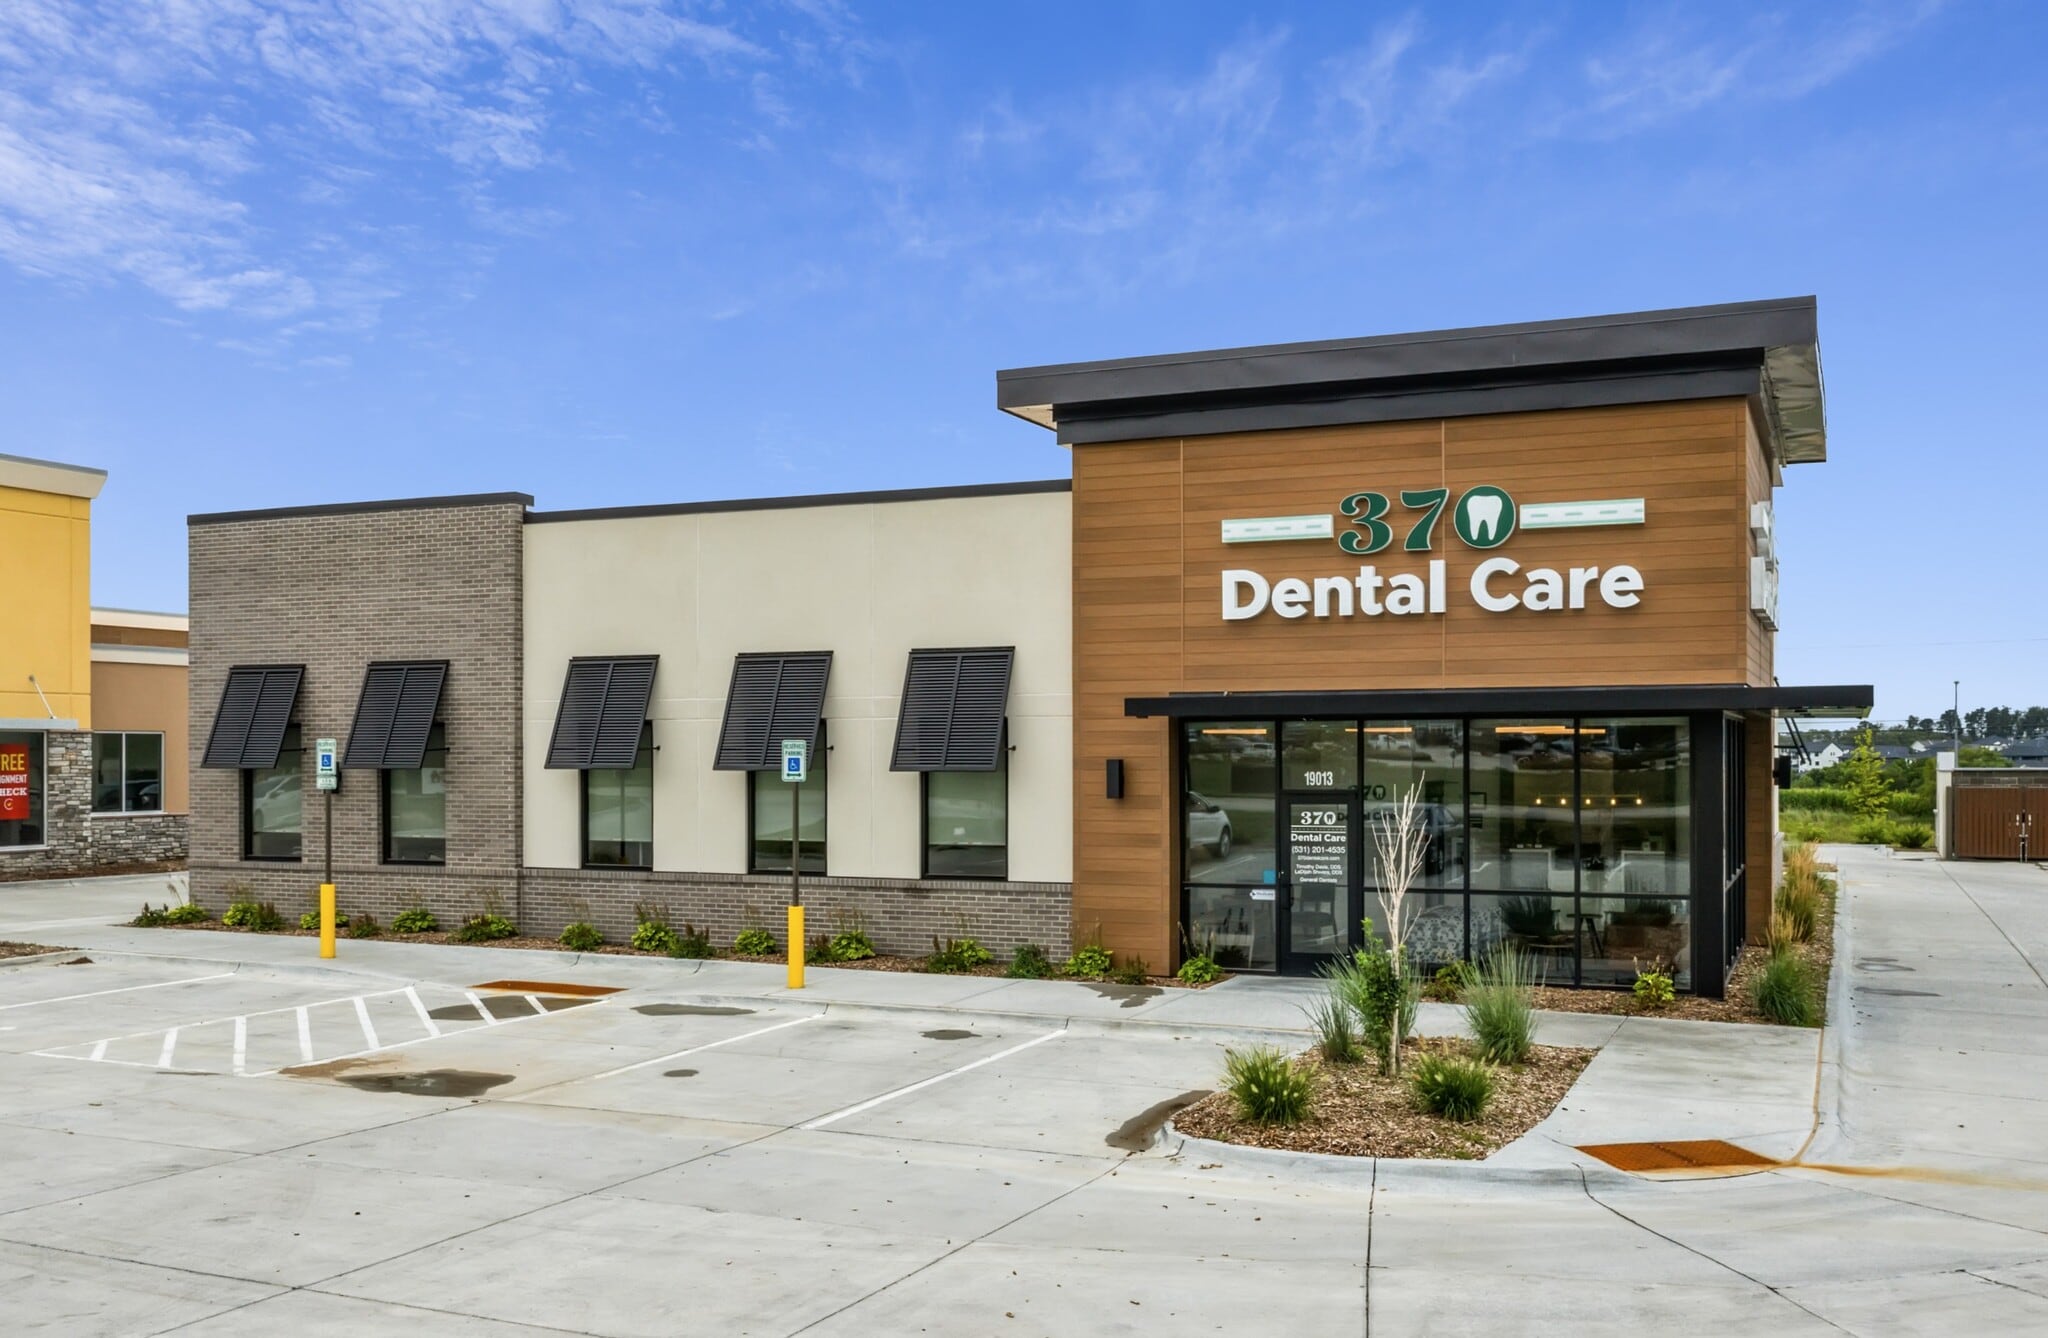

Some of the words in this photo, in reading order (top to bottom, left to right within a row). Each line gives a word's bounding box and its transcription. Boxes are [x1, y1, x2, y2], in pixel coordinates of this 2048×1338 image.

[1339, 485, 1516, 554] 370
[1221, 559, 1447, 620] Dental
[1470, 557, 1644, 613] Care
[0, 753, 25, 771] REE
[1303, 771, 1333, 786] 19013
[1300, 811, 1337, 825] 370
[1290, 833, 1322, 842] Dental
[1323, 833, 1346, 842] Care
[1291, 845, 1310, 855] (531)
[1311, 846, 1346, 854] 201-4535
